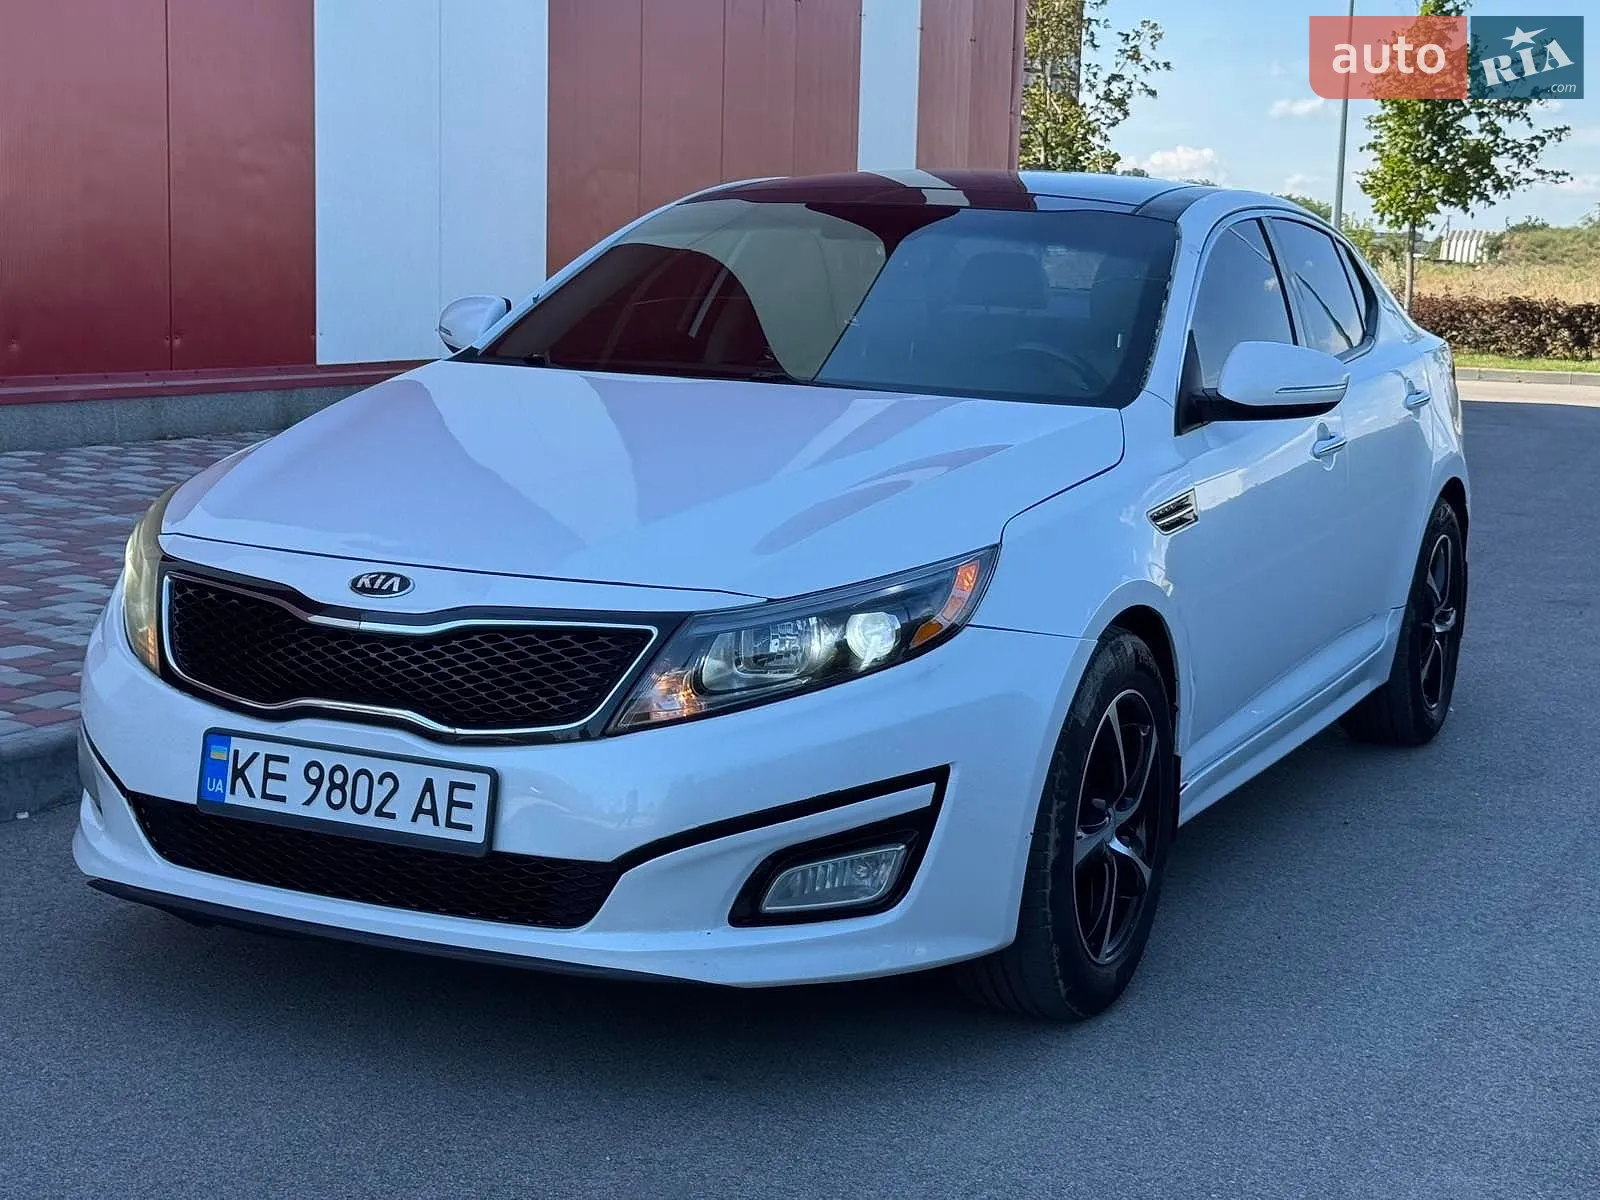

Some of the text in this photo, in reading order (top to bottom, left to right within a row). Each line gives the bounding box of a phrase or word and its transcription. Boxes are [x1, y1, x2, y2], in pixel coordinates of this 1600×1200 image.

[356, 574, 401, 592] KIA
[207, 776, 224, 793] UA
[229, 749, 477, 832] KE 9802 AE
